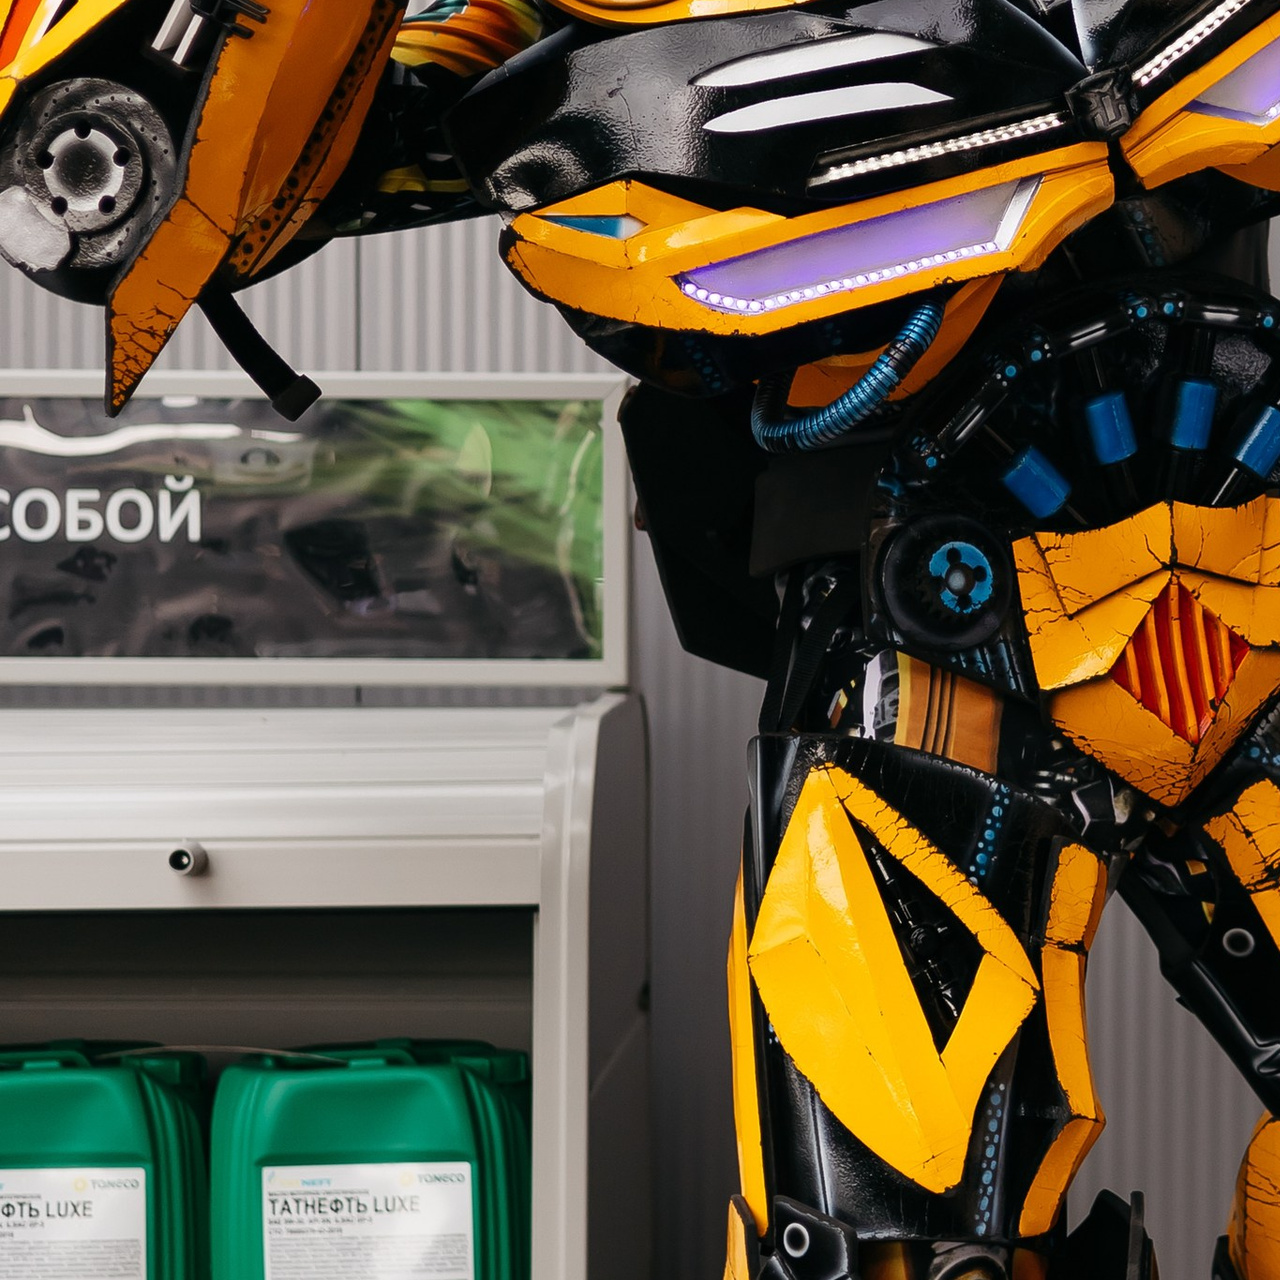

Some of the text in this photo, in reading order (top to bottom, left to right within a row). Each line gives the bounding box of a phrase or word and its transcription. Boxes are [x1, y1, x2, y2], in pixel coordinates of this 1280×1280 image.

[0, 474, 201, 543] ОБОЙ
[45, 1200, 94, 1218] LUXE
[268, 1194, 422, 1216] ТАТНЕФТЬ LUXE
